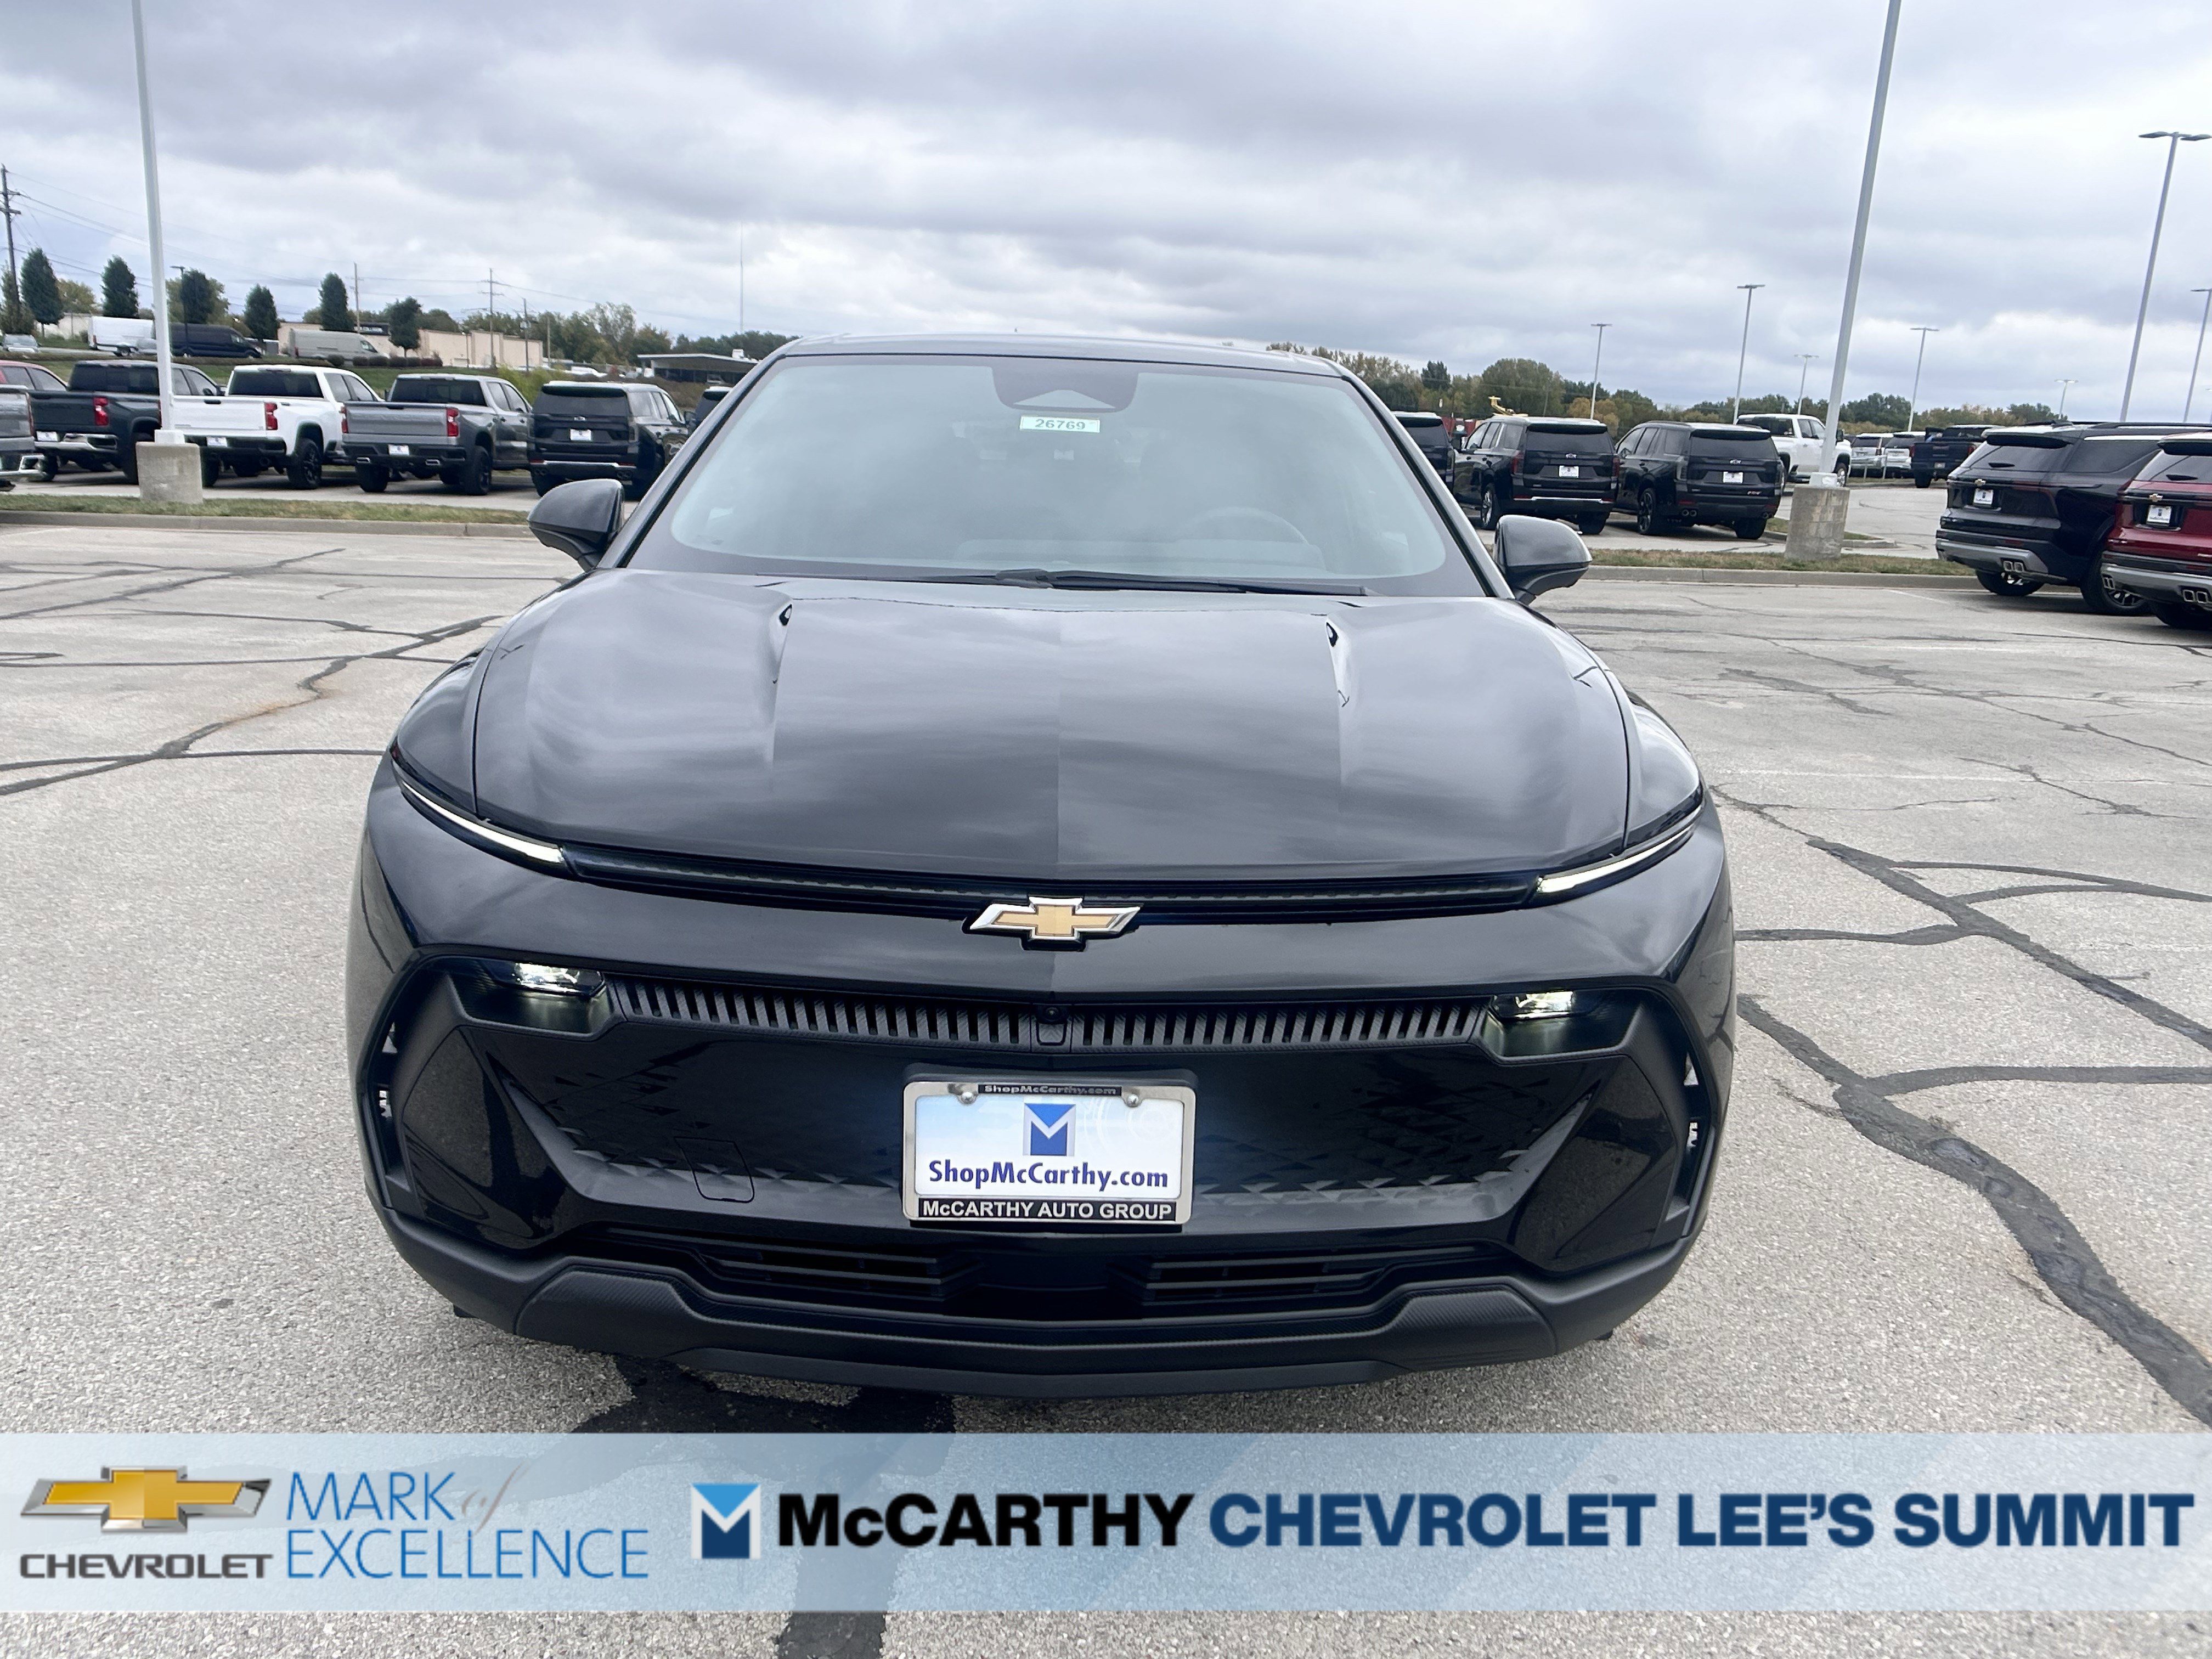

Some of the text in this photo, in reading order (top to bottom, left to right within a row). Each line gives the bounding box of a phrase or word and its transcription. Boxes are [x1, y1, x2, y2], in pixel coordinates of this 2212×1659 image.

[1035, 419, 1086, 430] 26769
[984, 1085, 1117, 1095] ShopMcCarthy.com
[929, 1159, 1168, 1192] ShopMcCarthy.com
[923, 1200, 1172, 1220] McCARTHY AUTO GROUP
